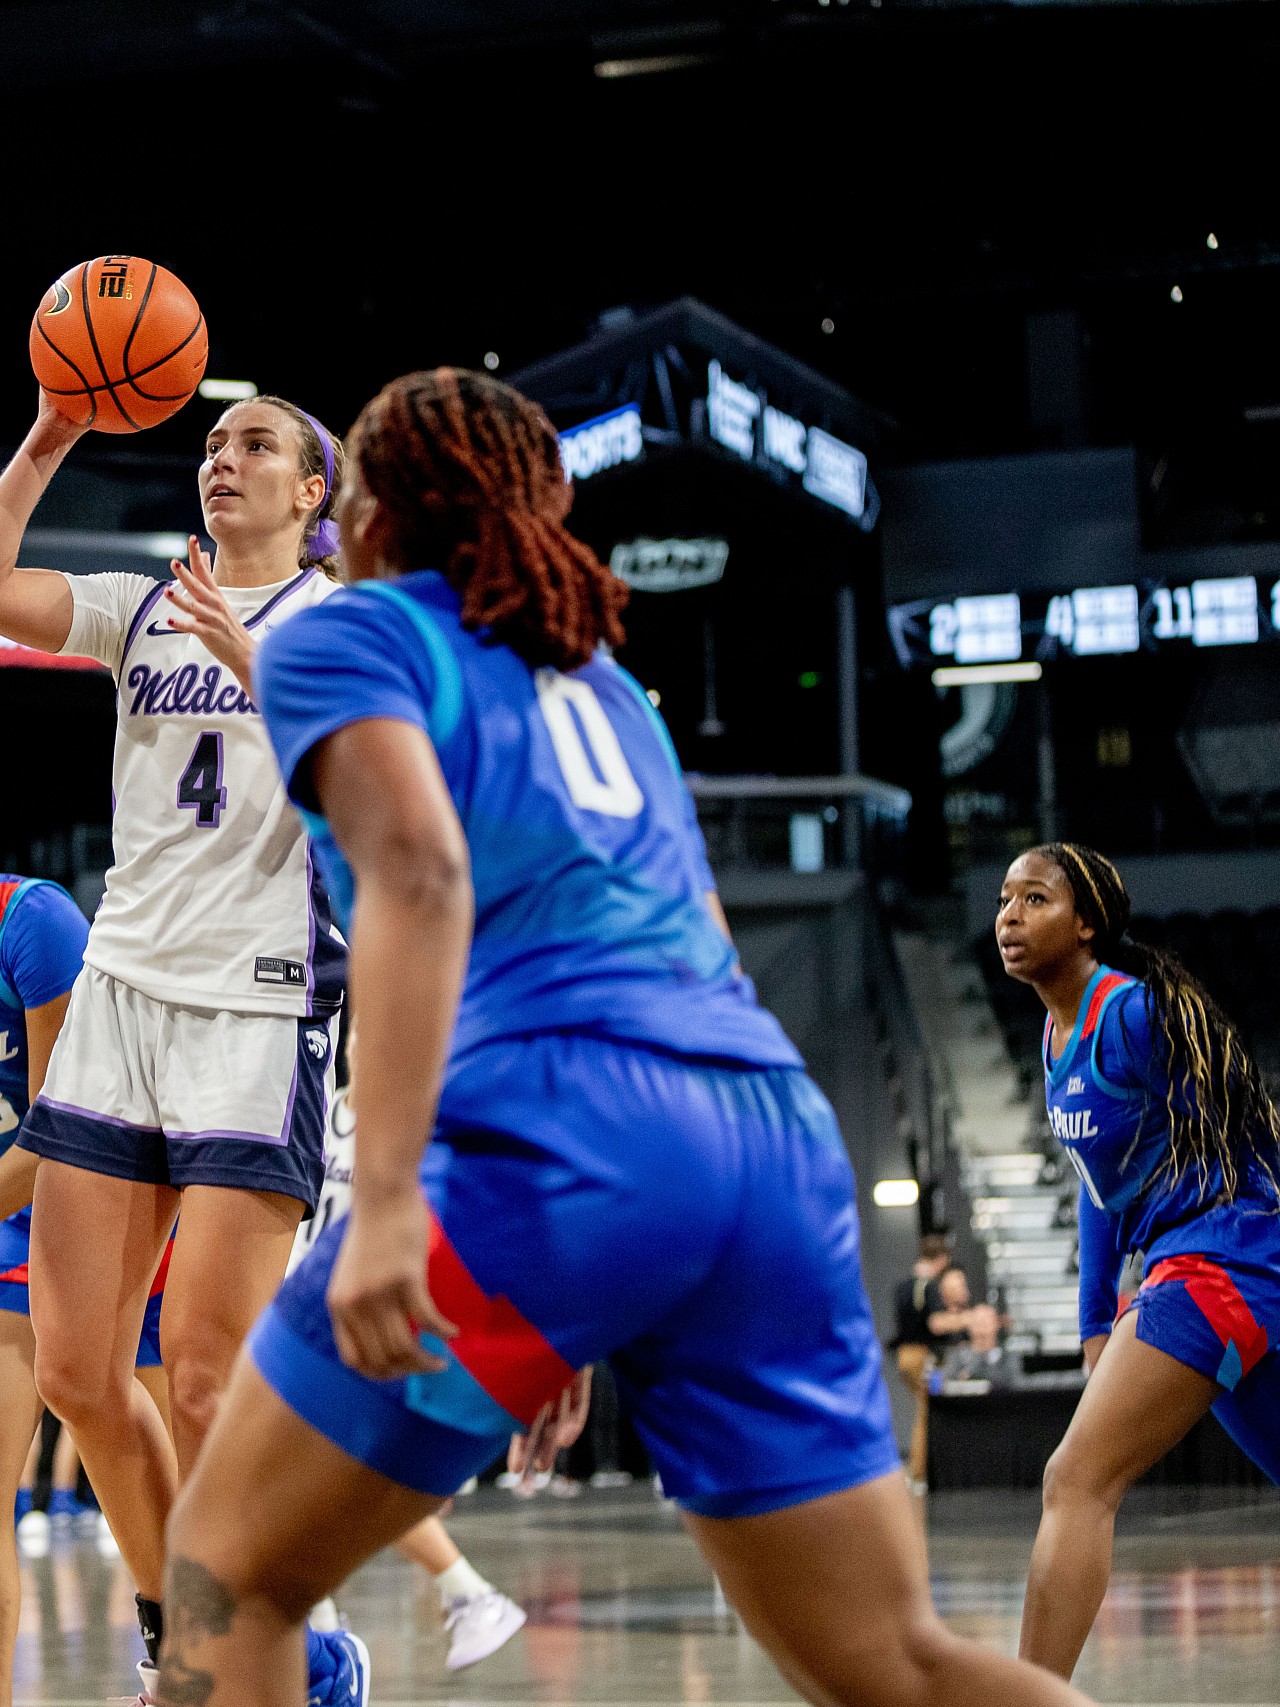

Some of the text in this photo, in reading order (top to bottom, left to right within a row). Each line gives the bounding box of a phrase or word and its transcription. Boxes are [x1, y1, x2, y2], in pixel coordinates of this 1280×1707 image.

[177, 731, 227, 828] 4
[534, 668, 644, 819] 0
[290, 967, 300, 979] M
